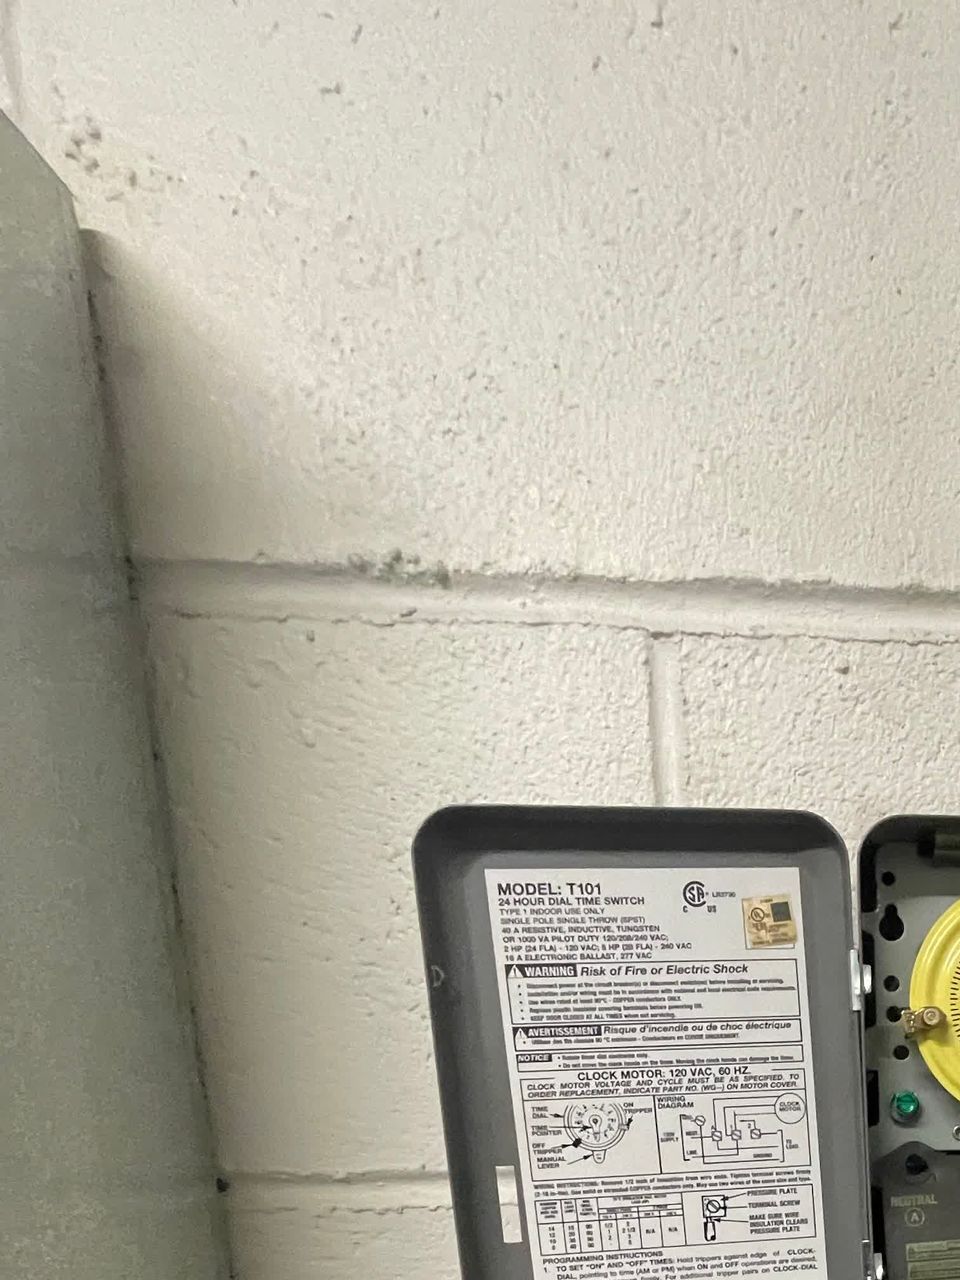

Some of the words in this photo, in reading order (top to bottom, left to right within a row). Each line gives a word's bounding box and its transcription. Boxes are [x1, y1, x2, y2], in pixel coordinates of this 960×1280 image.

[496, 882, 561, 896] MODEL:
[565, 882, 601, 895] T101
[497, 897, 511, 906] 24
[512, 896, 545, 906] HOUR
[547, 896, 572, 906] DIAL
[574, 896, 601, 905] TIME
[603, 896, 645, 905] SWITCH
[499, 907, 520, 915] TYPE
[529, 907, 562, 915] INDOOR
[563, 907, 581, 915] USE
[582, 907, 605, 915] ONLY
[520, 926, 566, 934] RESISTIVE,
[567, 925, 614, 933] INDUCTIVE,
[616, 924, 660, 932] TUNGSTEN
[550, 935, 575, 943] PILOT
[577, 934, 599, 942] DUTY
[649, 933, 669, 941] VAC;
[524, 966, 574, 977] WARNING
[579, 965, 606, 976] Risk
[609, 965, 622, 975] of
[623, 965, 647, 975] Fire
[650, 967, 663, 975] or
[665, 963, 710, 974] Electric
[712, 963, 748, 974] Shock
[527, 1025, 598, 1037] AVERTISSEMENT
[602, 1025, 637, 1035] Risque
[638, 1023, 689, 1033] d'incendie
[705, 1022, 718, 1031] de
[719, 1022, 743, 1031] choc
[744, 1020, 792, 1030] électrique
[517, 1054, 549, 1062] NOTICE
[576, 1070, 617, 1081] CLOCK
[620, 1068, 665, 1079] MOTOR:
[669, 1068, 687, 1077] 120
[689, 1066, 715, 1077] VAC,
[717, 1066, 731, 1075] 60
[733, 1065, 751, 1075] HZ.
[526, 1083, 555, 1091] CLOCK
[559, 1081, 590, 1089] MOTOR
[594, 1079, 632, 1088] VOLTAGE
[656, 1077, 683, 1085] CYCLE
[686, 1076, 710, 1084] MUST
[527, 1090, 557, 1098] ORDER
[558, 1088, 620, 1097] REPLACEMENT,
[622, 1086, 660, 1094] INDICATE
[739, 1081, 768, 1089] MOTOR
[656, 1095, 685, 1103] WIRING
[657, 1101, 694, 1109] DIAGRAM
[536, 1155, 565, 1163] MANUAL
[890, 1193, 938, 1207] NEUTRAL
[542, 1254, 604, 1265] PROGRAMMING
[605, 1249, 663, 1260] INSTRUCTIONS
[556, 1272, 577, 1280] DIAL,
[696, 1262, 708, 1270] ON
[724, 1260, 739, 1268] OFF
[772, 1262, 818, 1272] CLOCK-DIAL
